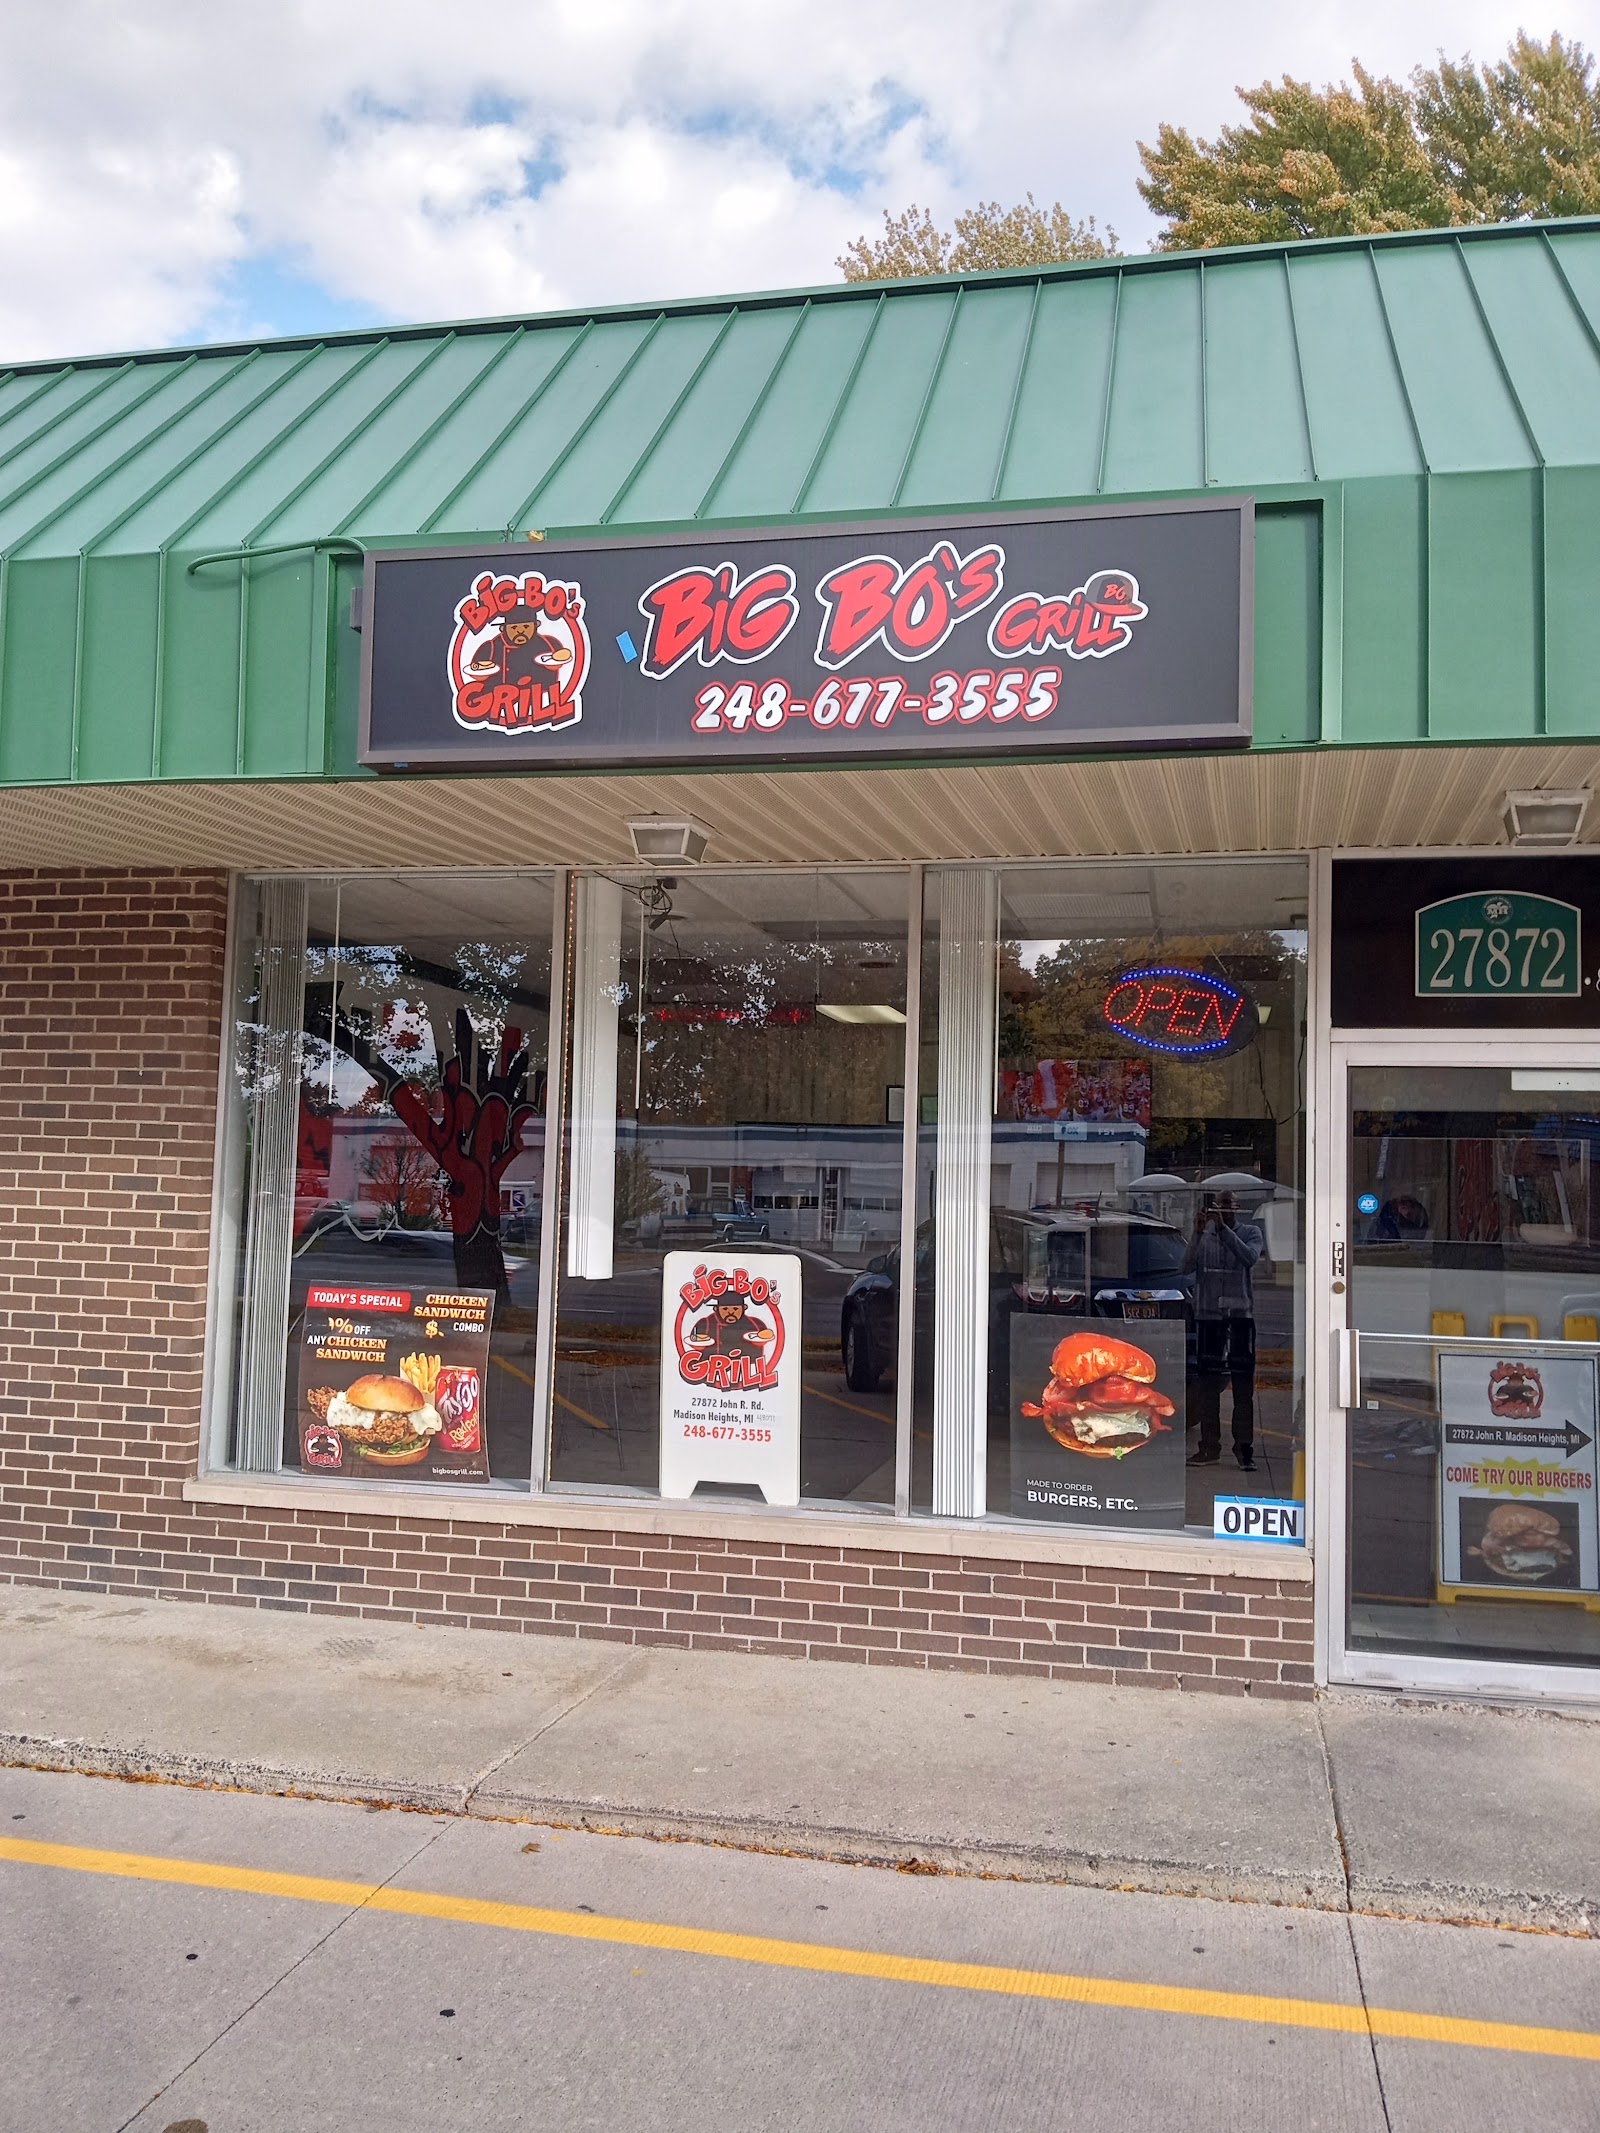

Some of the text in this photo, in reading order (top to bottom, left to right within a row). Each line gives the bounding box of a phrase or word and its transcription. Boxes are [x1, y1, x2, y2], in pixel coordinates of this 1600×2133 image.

[692, 669, 1060, 731] 248-677-3555
[1429, 928, 1566, 988] 27872
[1103, 981, 1244, 1039] OPEN
[1360, 1199, 1376, 1208] ADT
[1333, 1242, 1344, 1276] PULL
[313, 1291, 403, 1308] TODAY'S SPECIAL
[425, 1293, 488, 1307] CHICKEN
[413, 1305, 487, 1320] SANDWICH
[354, 1325, 371, 1335] OFF
[453, 1321, 484, 1333] COMBO
[306, 1335, 388, 1350] ANY CHICKEN
[315, 1348, 386, 1363] SANDWICH
[691, 1397, 764, 1411] 27872 John R. Rd.
[673, 1409, 706, 1420] Madison
[708, 1411, 742, 1425] Heights,
[744, 1414, 754, 1423] MI
[683, 1424, 772, 1443] 248-677-3555
[1452, 1428, 1580, 1446] 27872 John R. Madison Heights, MI
[432, 1467, 484, 1476] bigbosgrill.com
[1446, 1466, 1592, 1489] COME TRY OUR BURGERS
[1026, 1478, 1093, 1492] MADE TO ORDER
[1027, 1490, 1139, 1511] BURGERS, ETC.
[1222, 1505, 1299, 1538] OPEN
